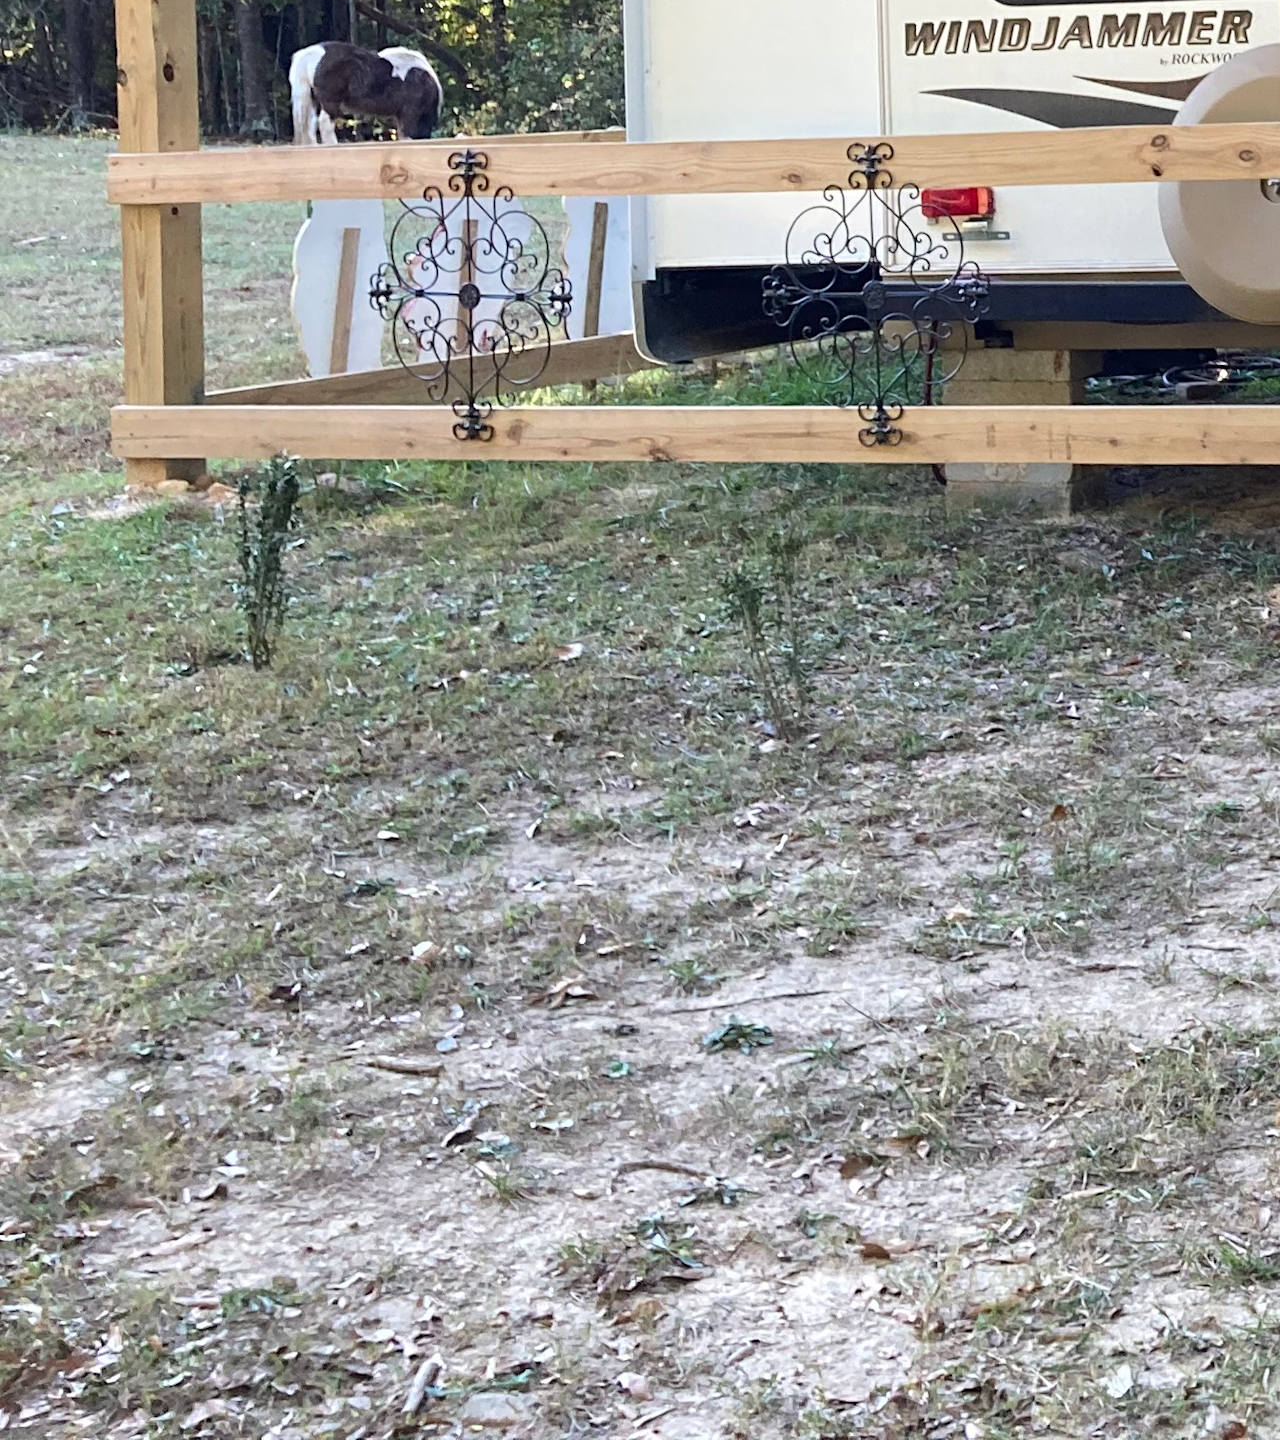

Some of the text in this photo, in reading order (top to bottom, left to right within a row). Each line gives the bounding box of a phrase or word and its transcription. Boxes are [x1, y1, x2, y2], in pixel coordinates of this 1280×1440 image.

[904, 10, 1253, 56] WINDJAMMER
[1160, 51, 1241, 67] by ROCKWO
